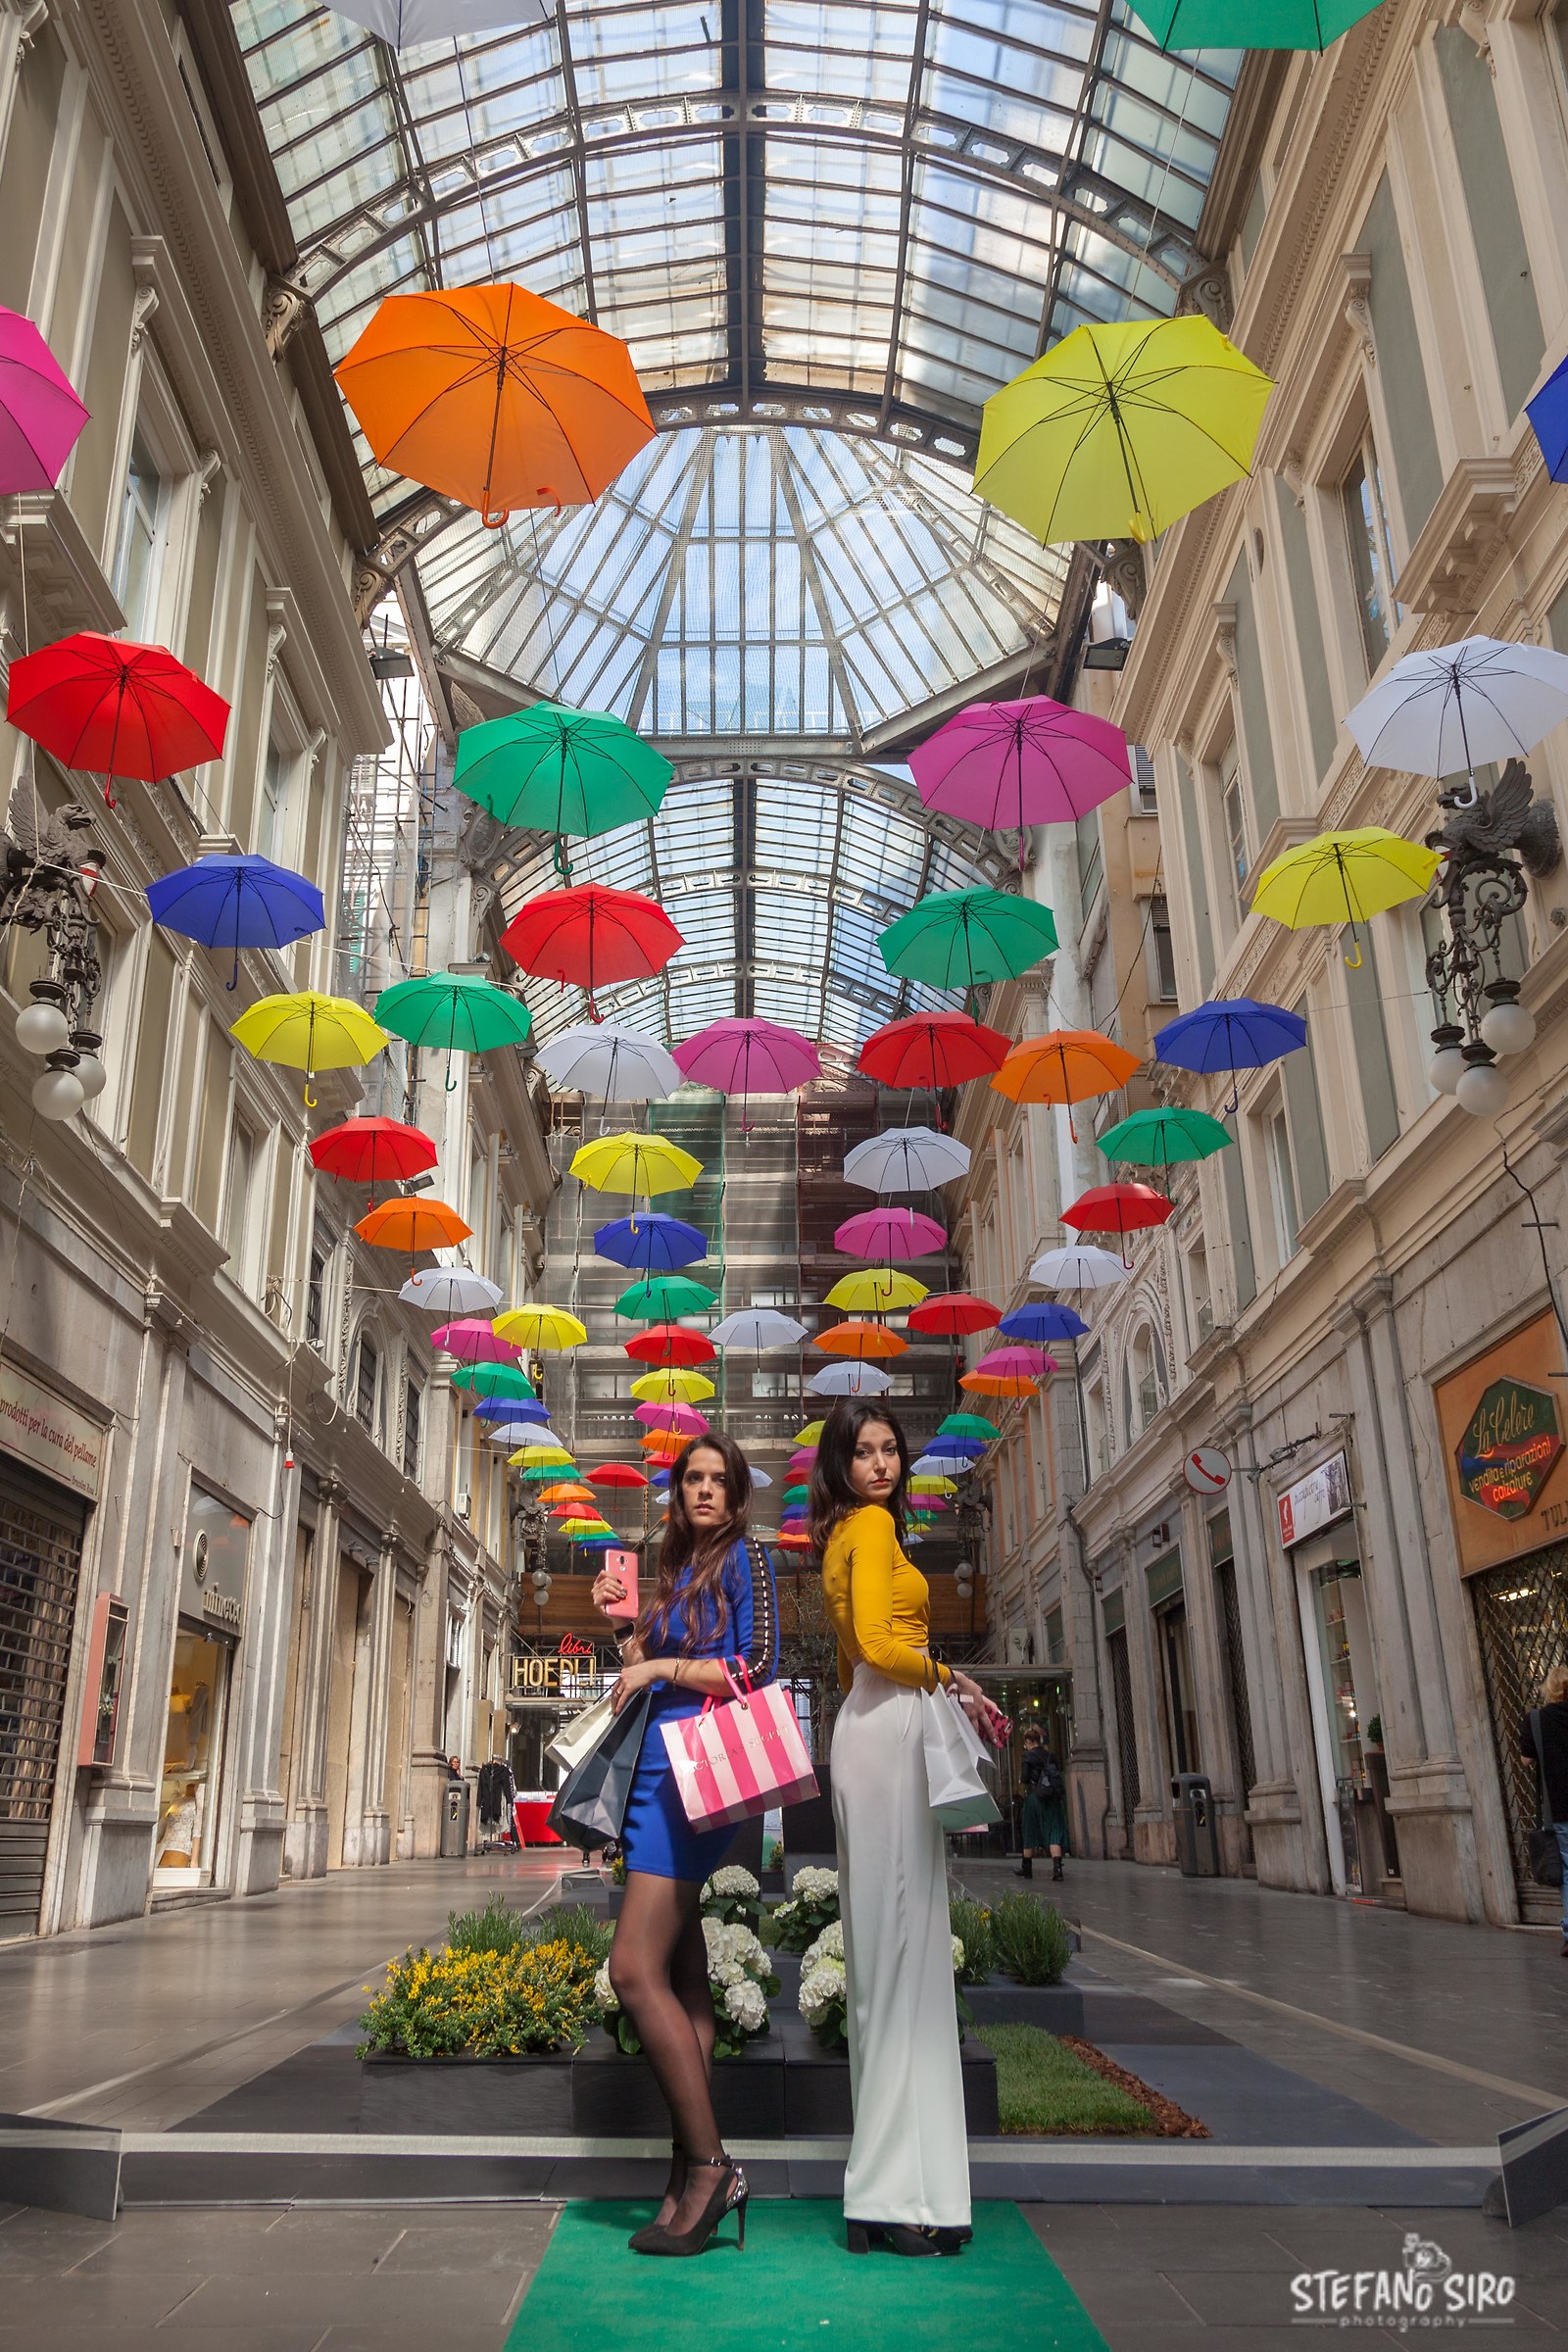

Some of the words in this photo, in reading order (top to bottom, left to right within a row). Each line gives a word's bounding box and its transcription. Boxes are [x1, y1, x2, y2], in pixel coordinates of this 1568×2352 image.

[0, 1398, 28, 1427] prodotti
[27, 1416, 40, 1435] per
[40, 1418, 48, 1439] la
[48, 1428, 63, 1447] cura
[64, 1433, 74, 1454] del
[74, 1442, 97, 1468] pellame
[1473, 1408, 1494, 1458] La
[1469, 1466, 1499, 1493] vendita
[1499, 1467, 1505, 1479] e
[1504, 1436, 1551, 1477] riparazioni
[1493, 1471, 1533, 1502] calzature
[1541, 1500, 1568, 1531] TUL
[558, 1633, 593, 1654] libri
[514, 1658, 594, 1687] HOEPLI
